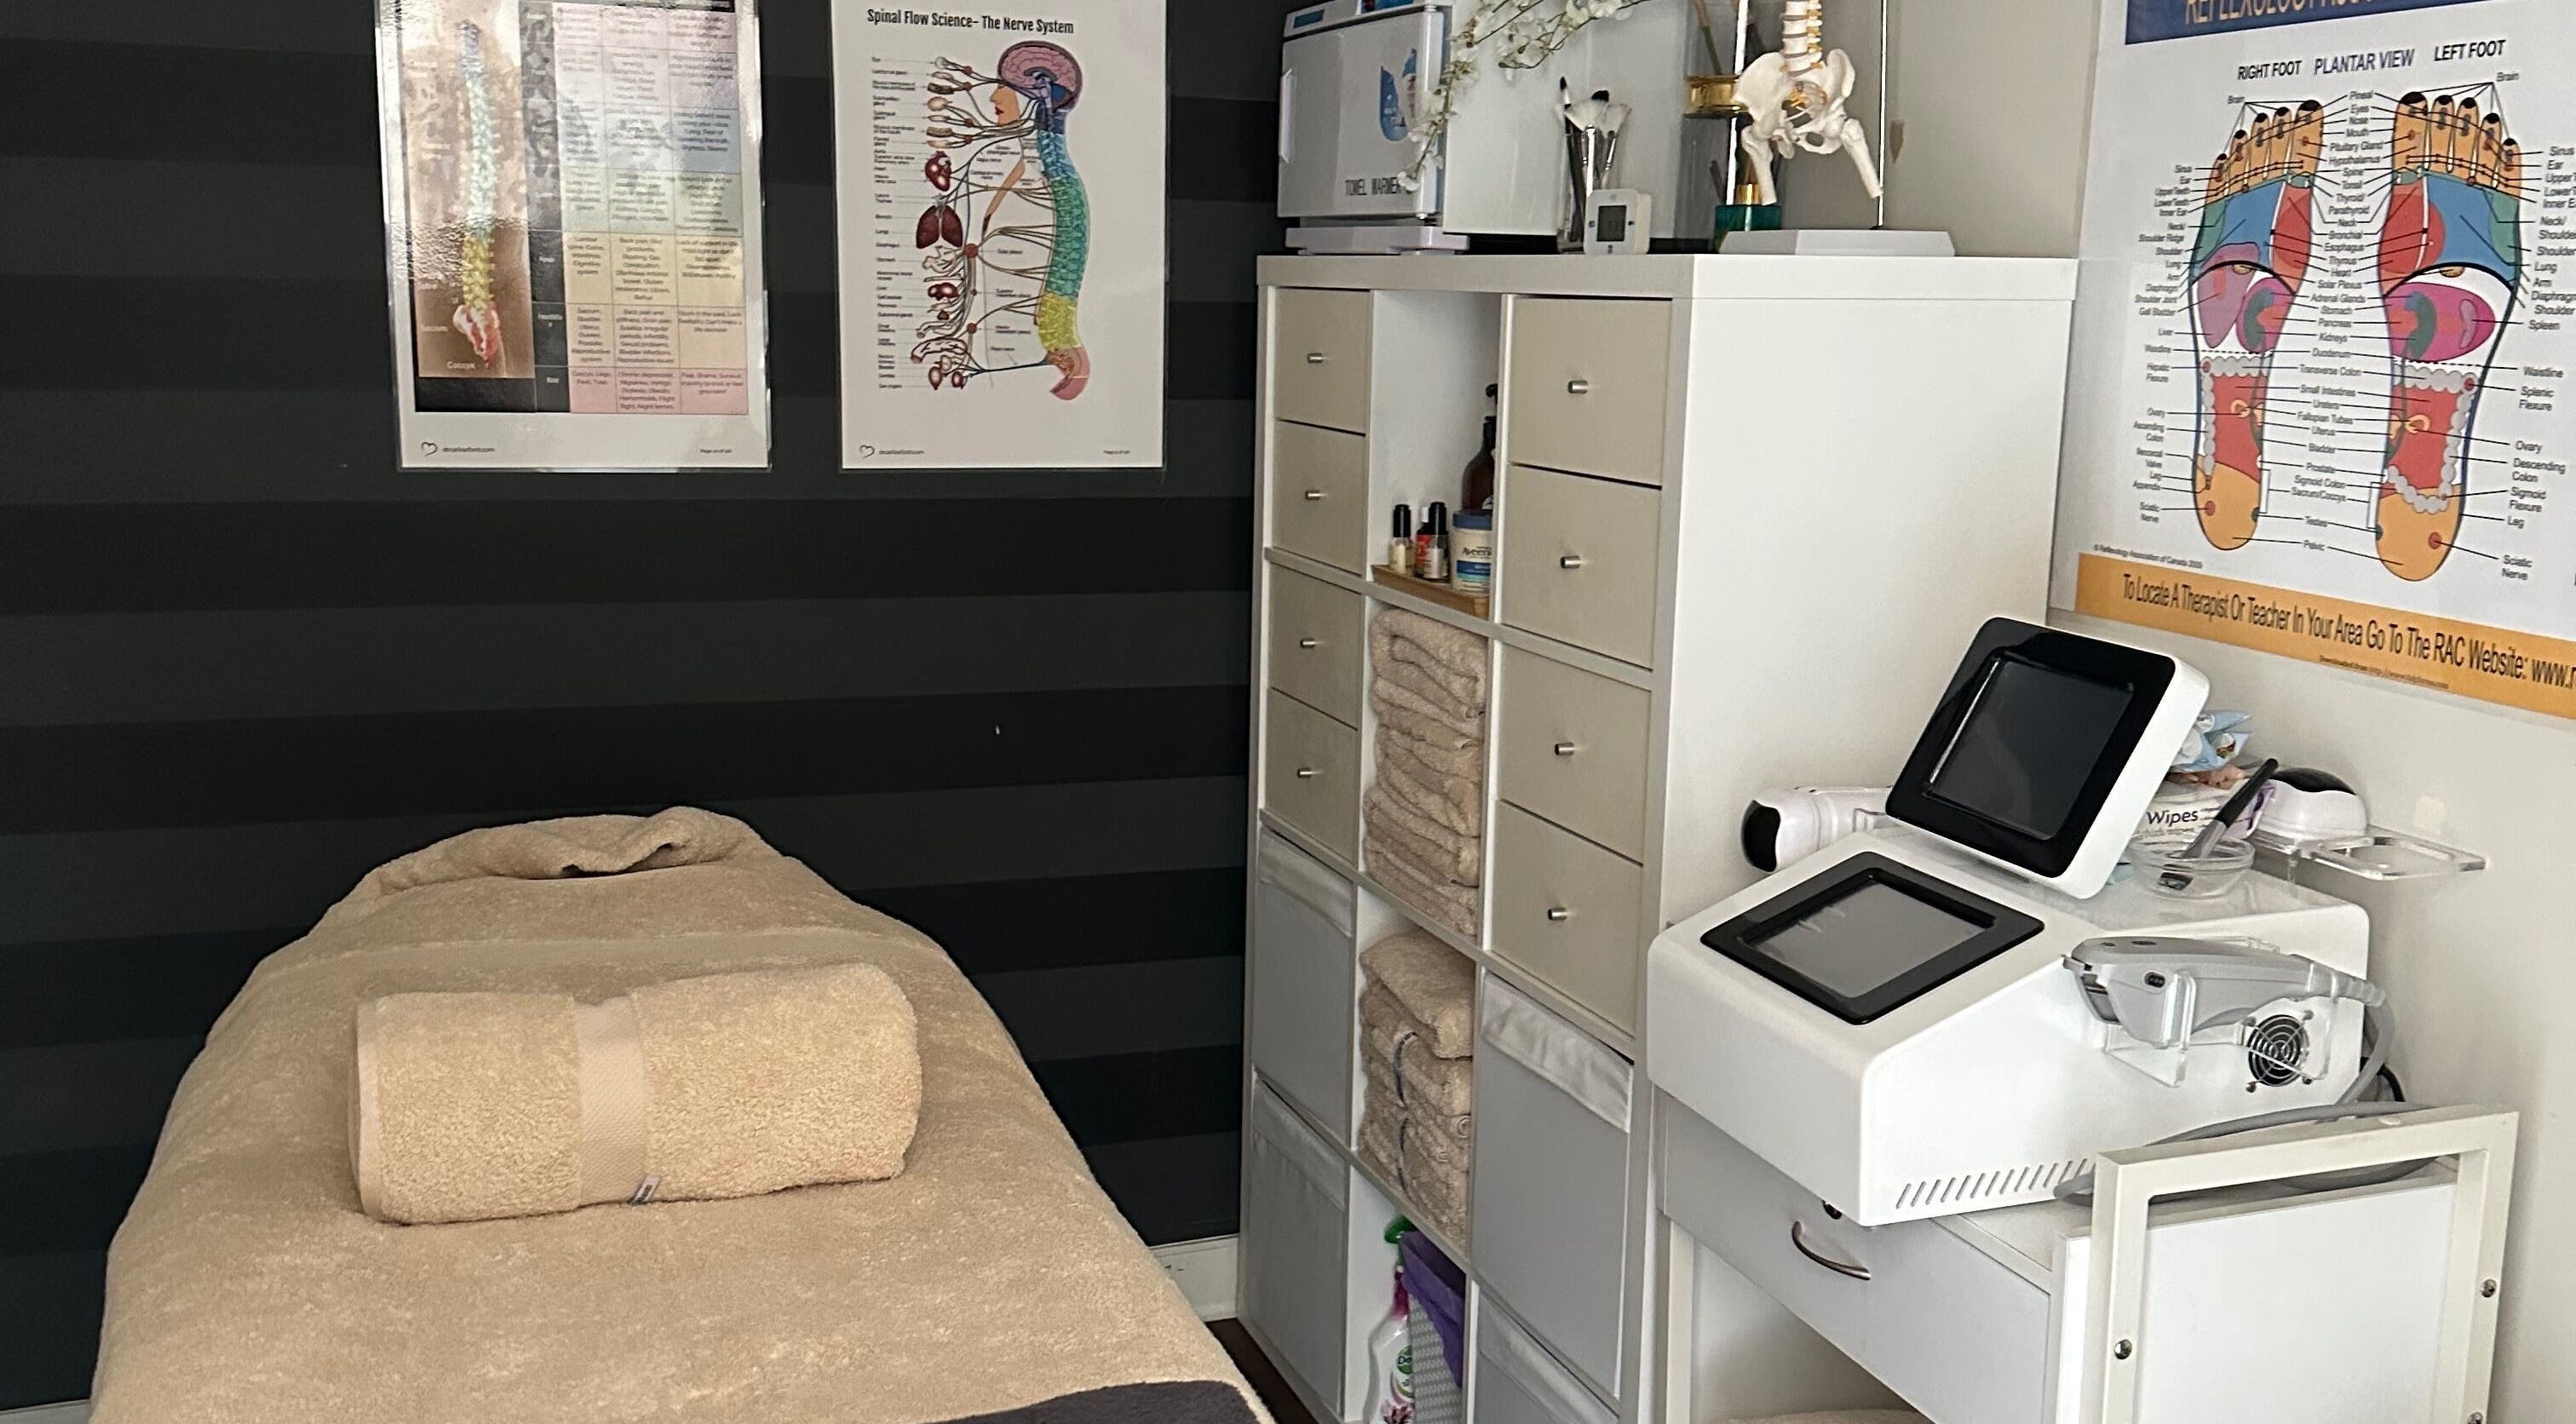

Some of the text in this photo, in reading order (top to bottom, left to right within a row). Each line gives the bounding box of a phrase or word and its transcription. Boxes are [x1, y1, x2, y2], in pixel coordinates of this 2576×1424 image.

[867, 8, 1073, 36] Spinal Flow Science- The Nerve System
[2434, 39, 2506, 61] LEFT FOOT
[2314, 49, 2414, 75] PLANTAR VIEW
[2238, 60, 2302, 80] RIGHT FOOT
[2496, 71, 2519, 82] Brain
[2228, 95, 2245, 105] Brain
[2351, 104, 2369, 115] Eyes
[2346, 129, 2369, 137] Mouth
[2360, 141, 2383, 150] Gland
[2547, 159, 2564, 170] Ear
[2543, 198, 2567, 208] Inner
[2539, 229, 2576, 239] Shoulde
[2534, 261, 2557, 273] Lung
[2533, 278, 2552, 287] Arm
[2534, 304, 2574, 315] Shoulder
[2528, 319, 2560, 330] Spleen
[2521, 386, 2555, 398] Splenic
[2519, 399, 2552, 411] Flexure
[2515, 440, 2542, 454] Ovary
[2513, 457, 2566, 474] Descending
[2512, 471, 2539, 483] Colon
[2510, 486, 2547, 499] Sigmoid
[2509, 499, 2542, 513] Flexure
[2507, 515, 2524, 529] Leg
[2503, 554, 2533, 568] Sciatic
[2124, 573, 2134, 600] To
[2136, 576, 2169, 606] Locate
[2170, 583, 2180, 607] A
[2182, 583, 2228, 622] Therapist
[2231, 594, 2245, 621] Or
[2247, 596, 2291, 630] Teacher
[2292, 605, 2303, 634] In
[2307, 607, 2333, 639] Your
[2333, 613, 2362, 646] Area
[2366, 619, 2384, 650] Go
[2389, 623, 2403, 654] To
[2406, 626, 2430, 660] The
[2433, 632, 2465, 667] RAC
[2470, 639, 2529, 680] Website:
[2146, 809, 2199, 827] Wipes
